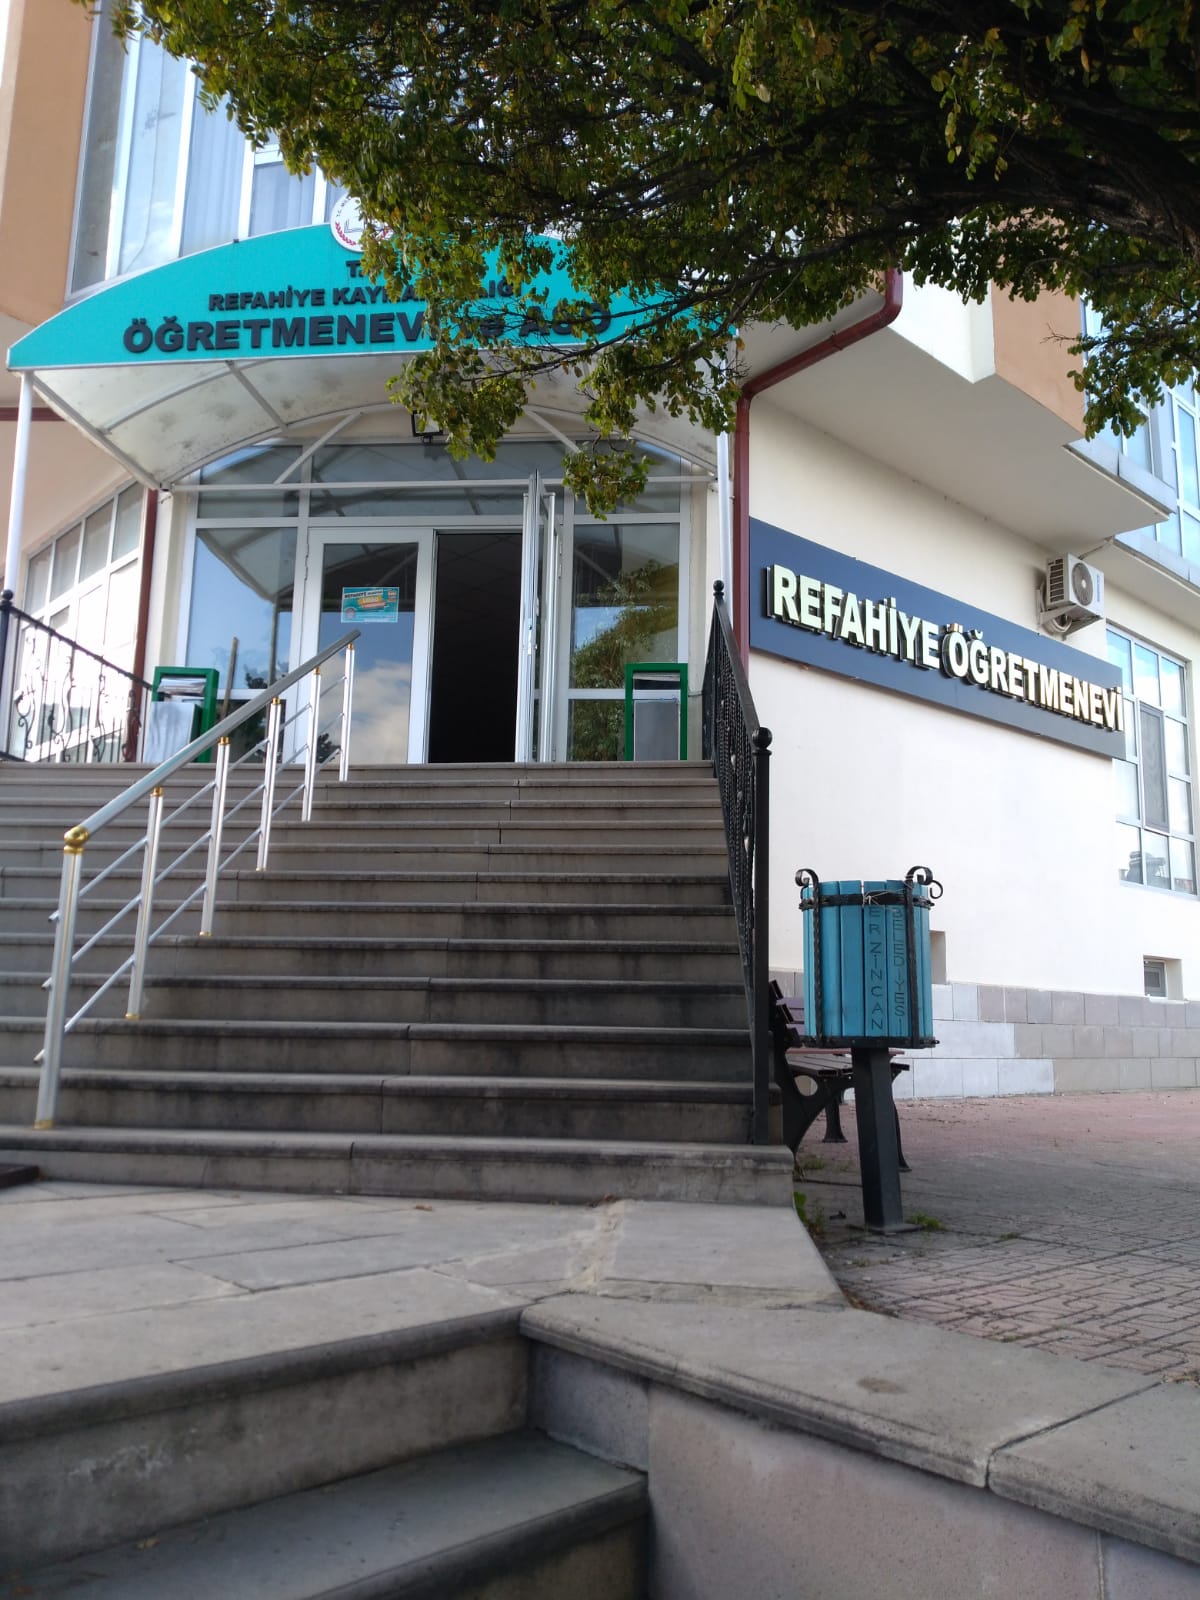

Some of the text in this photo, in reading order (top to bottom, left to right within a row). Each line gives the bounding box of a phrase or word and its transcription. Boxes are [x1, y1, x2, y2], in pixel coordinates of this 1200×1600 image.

[208, 285, 326, 312] REFAHİYE
[123, 310, 439, 354] ÖĞRETMENEV
[766, 563, 1125, 732] REFAHİYE ÖĞRETMENEVİ
